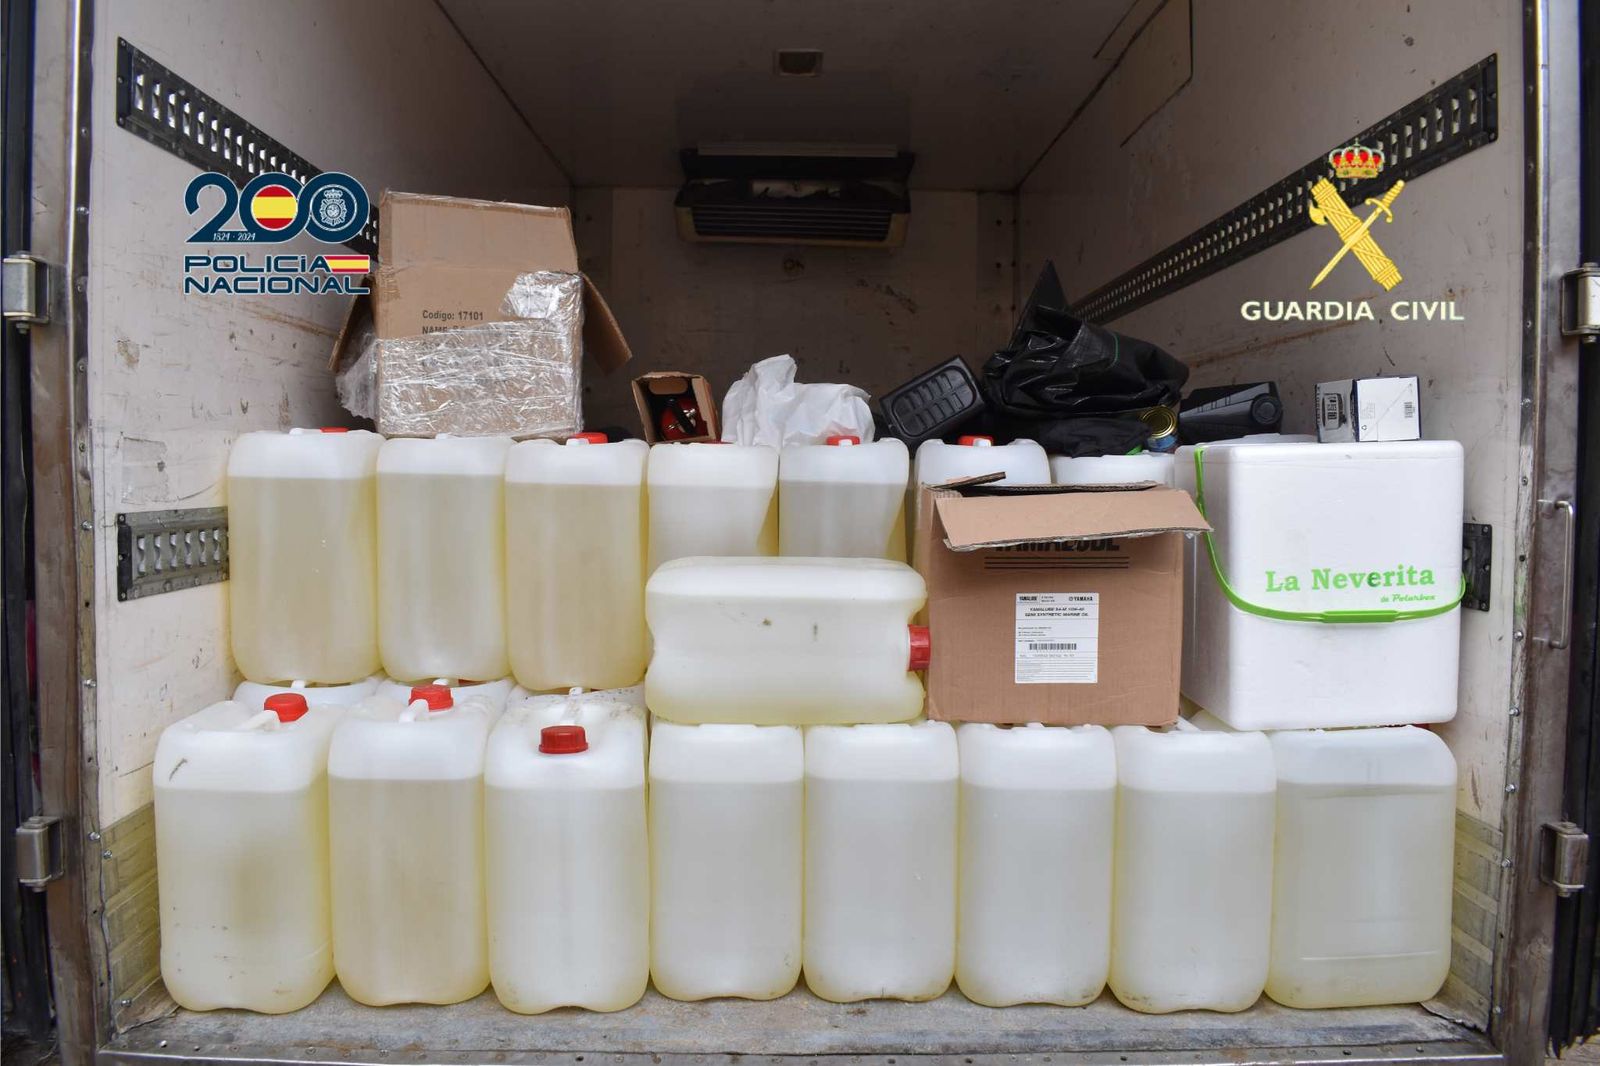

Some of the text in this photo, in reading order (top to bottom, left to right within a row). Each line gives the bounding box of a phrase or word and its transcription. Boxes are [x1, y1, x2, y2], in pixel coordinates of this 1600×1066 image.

[422, 310, 484, 321] Codigo: 17101
[1265, 564, 1435, 592] La Neverita
